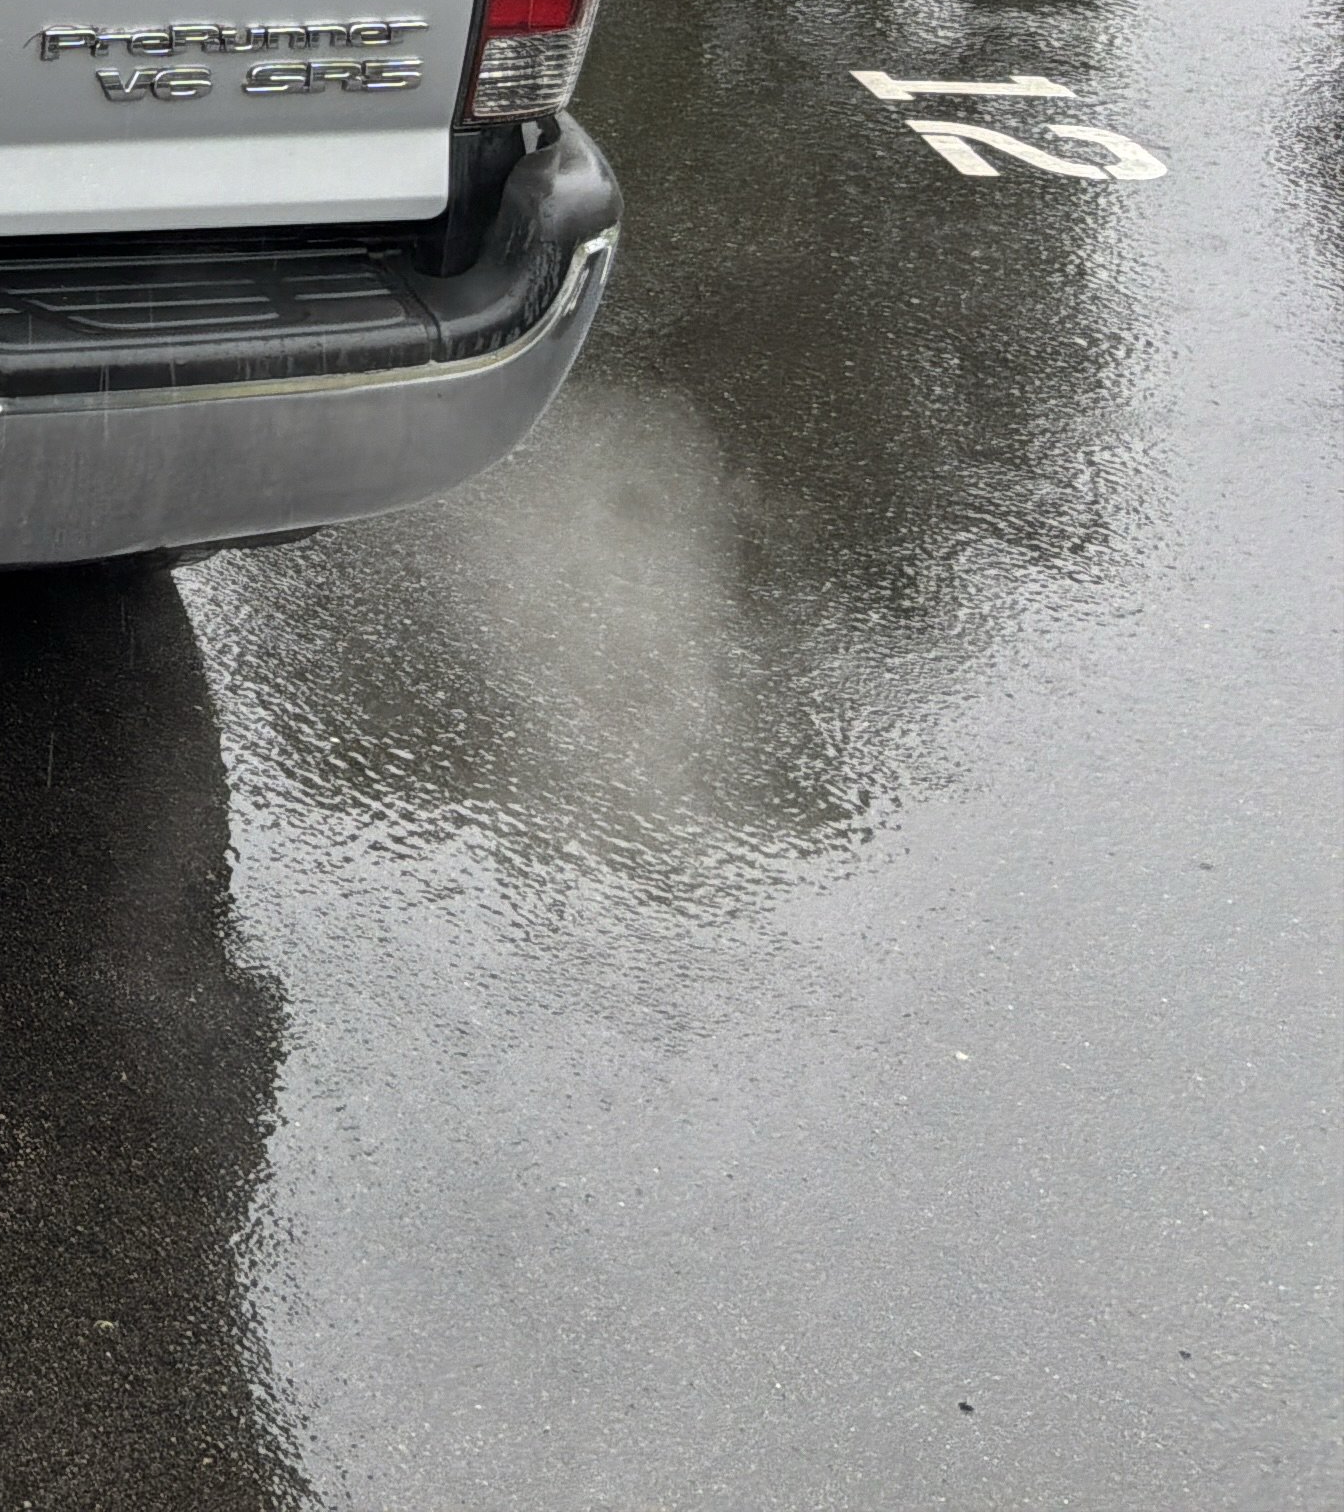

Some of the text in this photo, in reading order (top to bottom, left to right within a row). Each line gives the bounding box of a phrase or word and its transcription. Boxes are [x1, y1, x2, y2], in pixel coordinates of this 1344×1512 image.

[40, 21, 429, 61] PreRunner
[96, 58, 424, 102] V6 SR5
